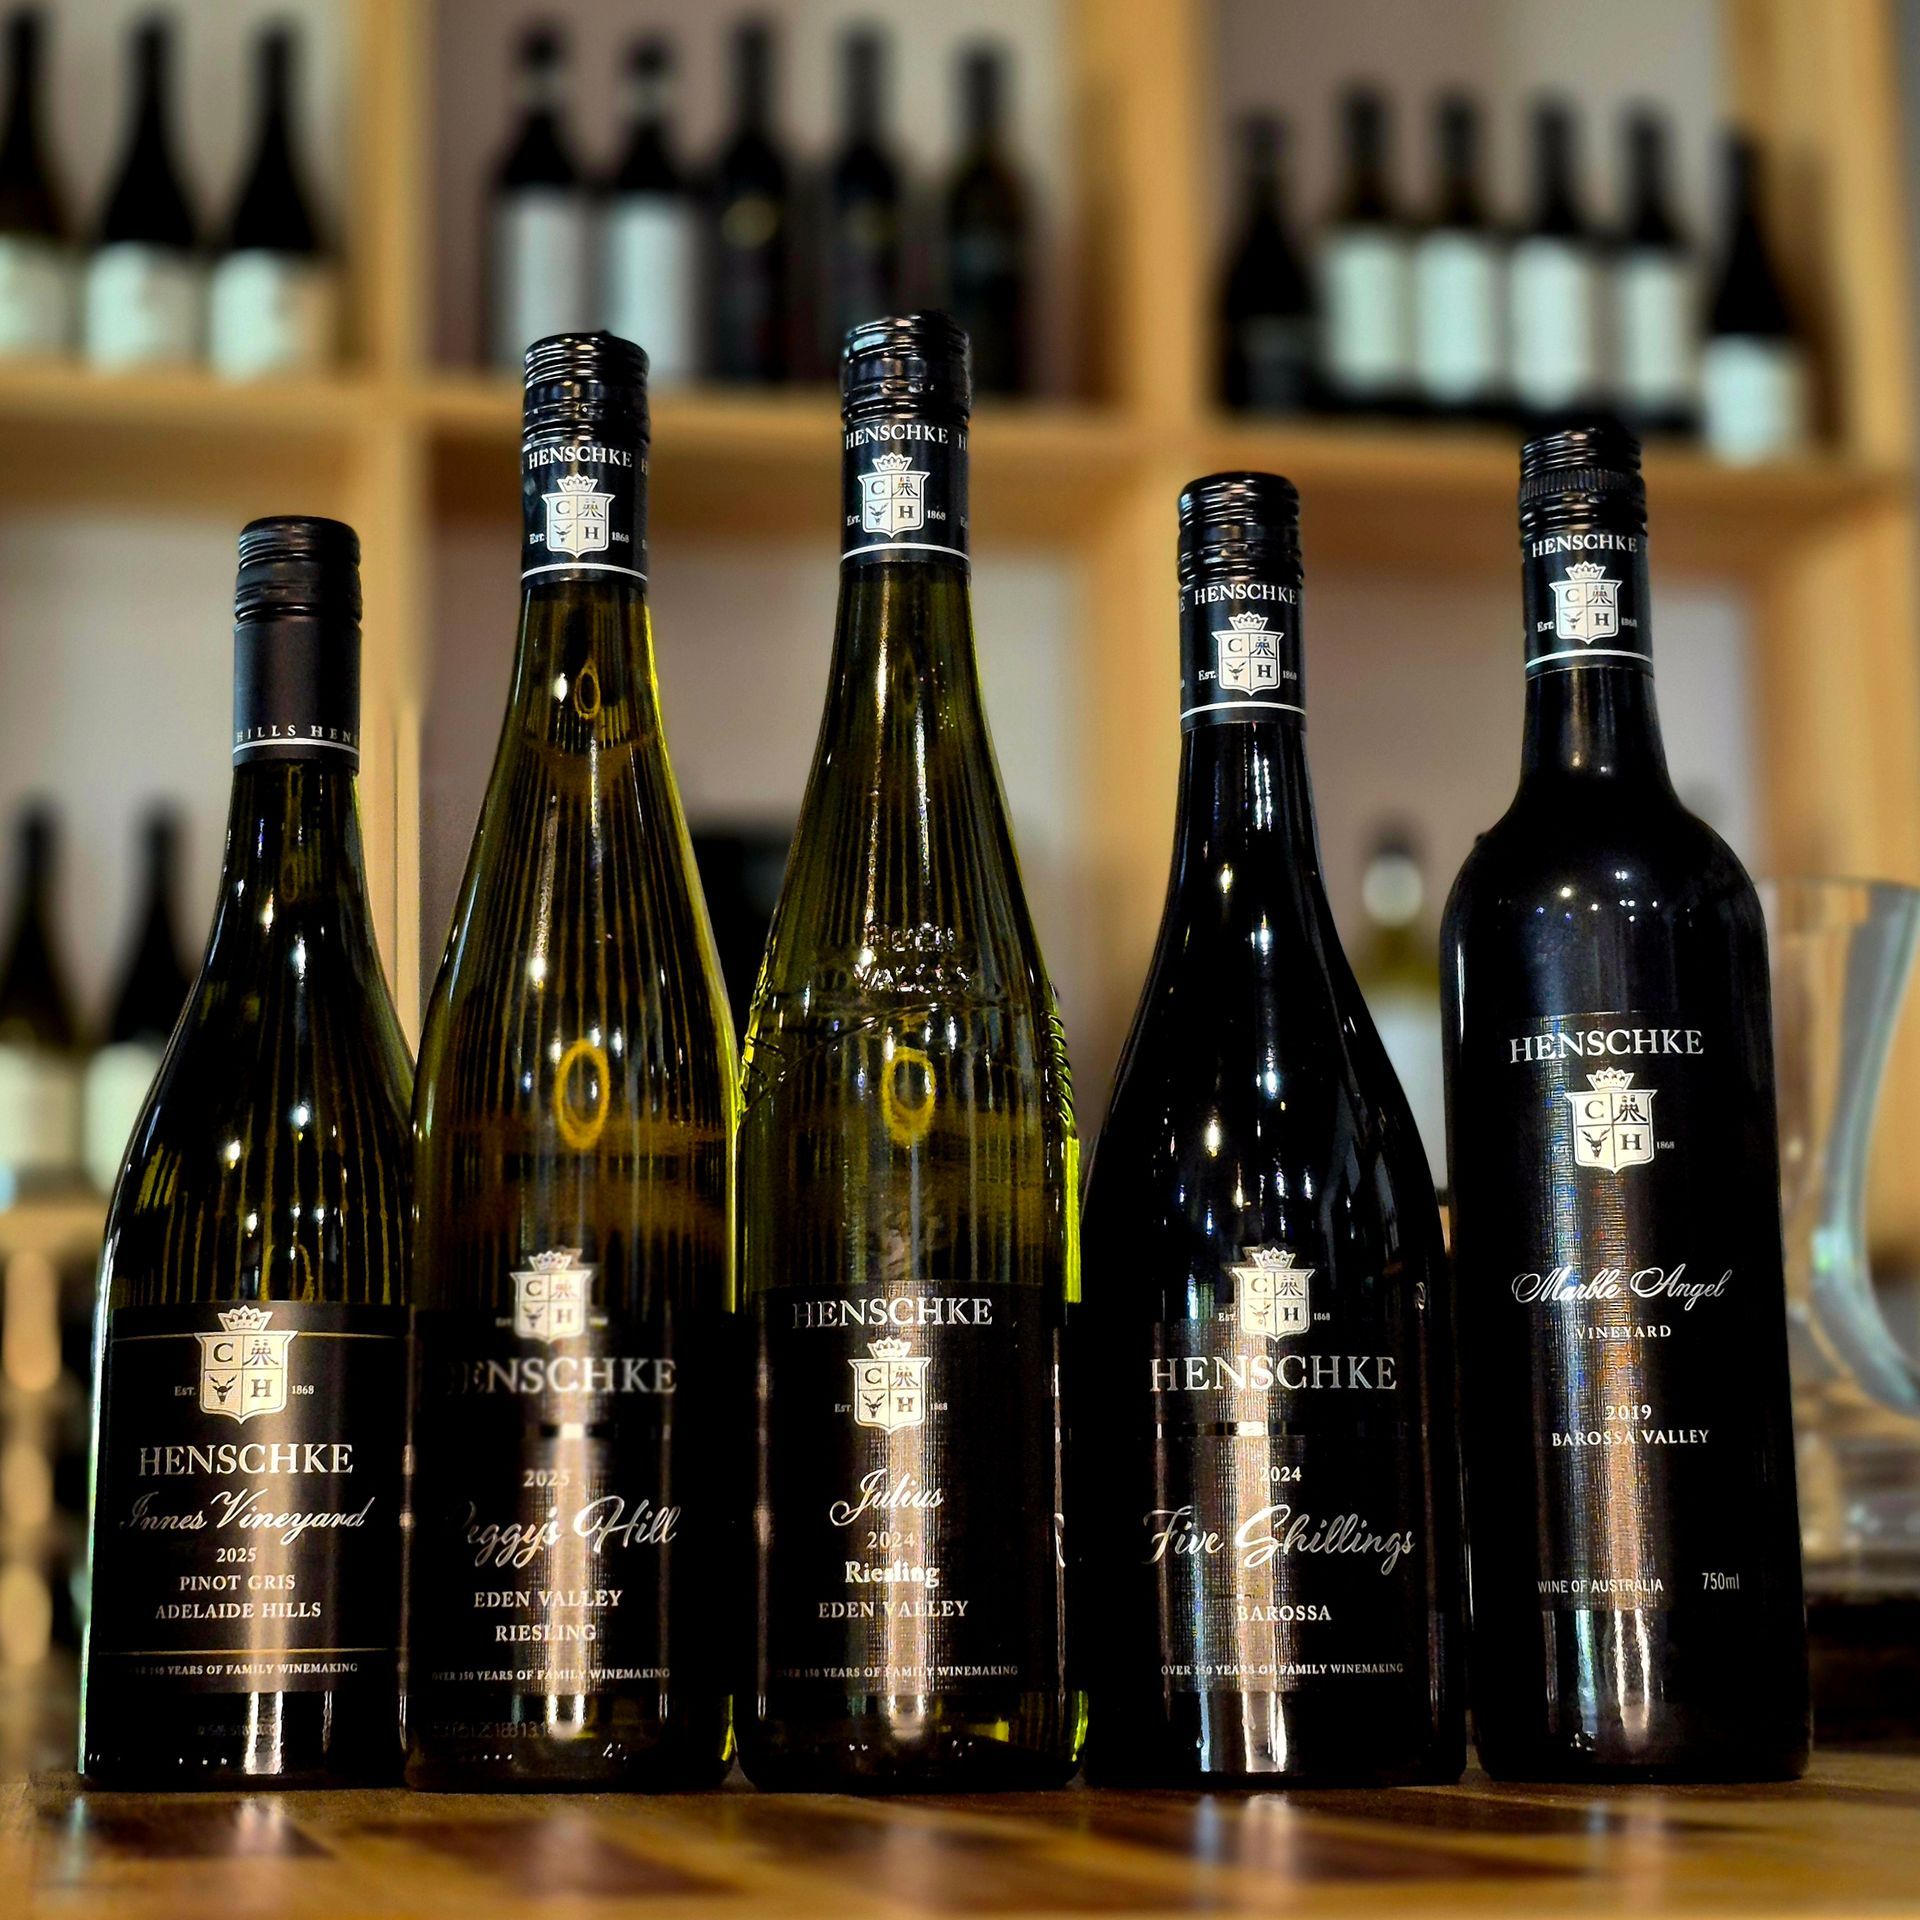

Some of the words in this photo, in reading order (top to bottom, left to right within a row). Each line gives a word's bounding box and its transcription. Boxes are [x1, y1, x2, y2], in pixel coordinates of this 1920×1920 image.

[846, 424, 948, 450] HENSCHKE
[528, 446, 632, 470] HENSCHKE
[871, 480, 885, 495] C
[556, 501, 570, 514] C
[898, 506, 914, 518] H
[927, 510, 946, 520] 1868
[585, 527, 598, 539] H
[1532, 534, 1637, 558] HENSCHKE
[1194, 584, 1297, 605] HENSCHKE
[1566, 588, 1580, 602] C
[1595, 613, 1609, 626] H
[1228, 639, 1242, 652] C
[1257, 664, 1272, 678] H
[237, 724, 296, 743] HILLS
[1509, 1029, 1704, 1064] HENSCHKE
[1585, 1100, 1605, 1120] C
[1620, 1133, 1643, 1151] H
[1656, 1141, 1675, 1150] 1868
[526, 1280, 543, 1296] C
[1251, 1277, 1268, 1293] C
[1511, 1265, 1622, 1303] Marble
[1630, 1263, 1733, 1311] Angel
[556, 1309, 572, 1324] H
[792, 1297, 993, 1329] HENSCHKE
[1283, 1307, 1299, 1321] H
[1576, 1325, 1672, 1340] VINEYARD
[213, 1342, 233, 1363] C
[448, 1357, 677, 1394] NSCHKE
[865, 1368, 881, 1384] C
[1149, 1354, 1397, 1392] HENSCHKE
[251, 1379, 271, 1397] H
[291, 1384, 315, 1395] 1868
[896, 1397, 914, 1412] H
[1605, 1404, 1652, 1421] 2019
[1552, 1431, 1635, 1447] BAROSSA
[1641, 1429, 1710, 1444] VALLEY
[137, 1443, 354, 1477] HENSCHKE
[523, 1469, 570, 1487] 2025
[1259, 1466, 1303, 1482] 2024
[829, 1467, 944, 1526] Julius
[119, 1491, 208, 1531] Innes
[210, 1487, 376, 1545] Vineyard
[574, 1495, 681, 1553] Hill
[867, 1531, 916, 1550] 2024
[1140, 1505, 1225, 1565] Five
[1234, 1503, 1416, 1576] Shillings
[216, 1547, 257, 1563] 2025
[845, 1559, 940, 1589] Riesling
[1701, 1572, 1740, 1590] 750ml
[179, 1575, 241, 1592] PINOT
[247, 1574, 296, 1591] GRIS
[1537, 1580, 1568, 1593] WINE
[1571, 1580, 1588, 1593] OF
[1591, 1578, 1664, 1593] AUSTRALIA
[474, 1591, 530, 1608] EDEN
[537, 1590, 623, 1607] VALLEY
[155, 1602, 254, 1619] ADELAIDE
[261, 1601, 321, 1618] HILLS
[818, 1602, 875, 1618] EDEN
[883, 1600, 969, 1617] VALLEY
[1237, 1605, 1332, 1621] BAROSSA
[495, 1625, 597, 1641] RIESLING
[167, 1665, 203, 1675] YEARS
[206, 1665, 223, 1675] OF
[226, 1664, 274, 1674] FAMILY
[278, 1663, 358, 1674] WINEMAKING
[477, 1670, 513, 1681] YEARS
[516, 1670, 533, 1680] OF
[589, 1668, 670, 1679] WINEMAKING
[823, 1667, 860, 1678] YEARS
[863, 1667, 881, 1678] OF
[937, 1665, 1018, 1676] WINEMAKING
[1160, 1665, 1191, 1675] OVER
[1215, 1664, 1255, 1675] YEARS
[1280, 1664, 1328, 1675] FAMILY
[1331, 1663, 1404, 1674] WINEMAKING
